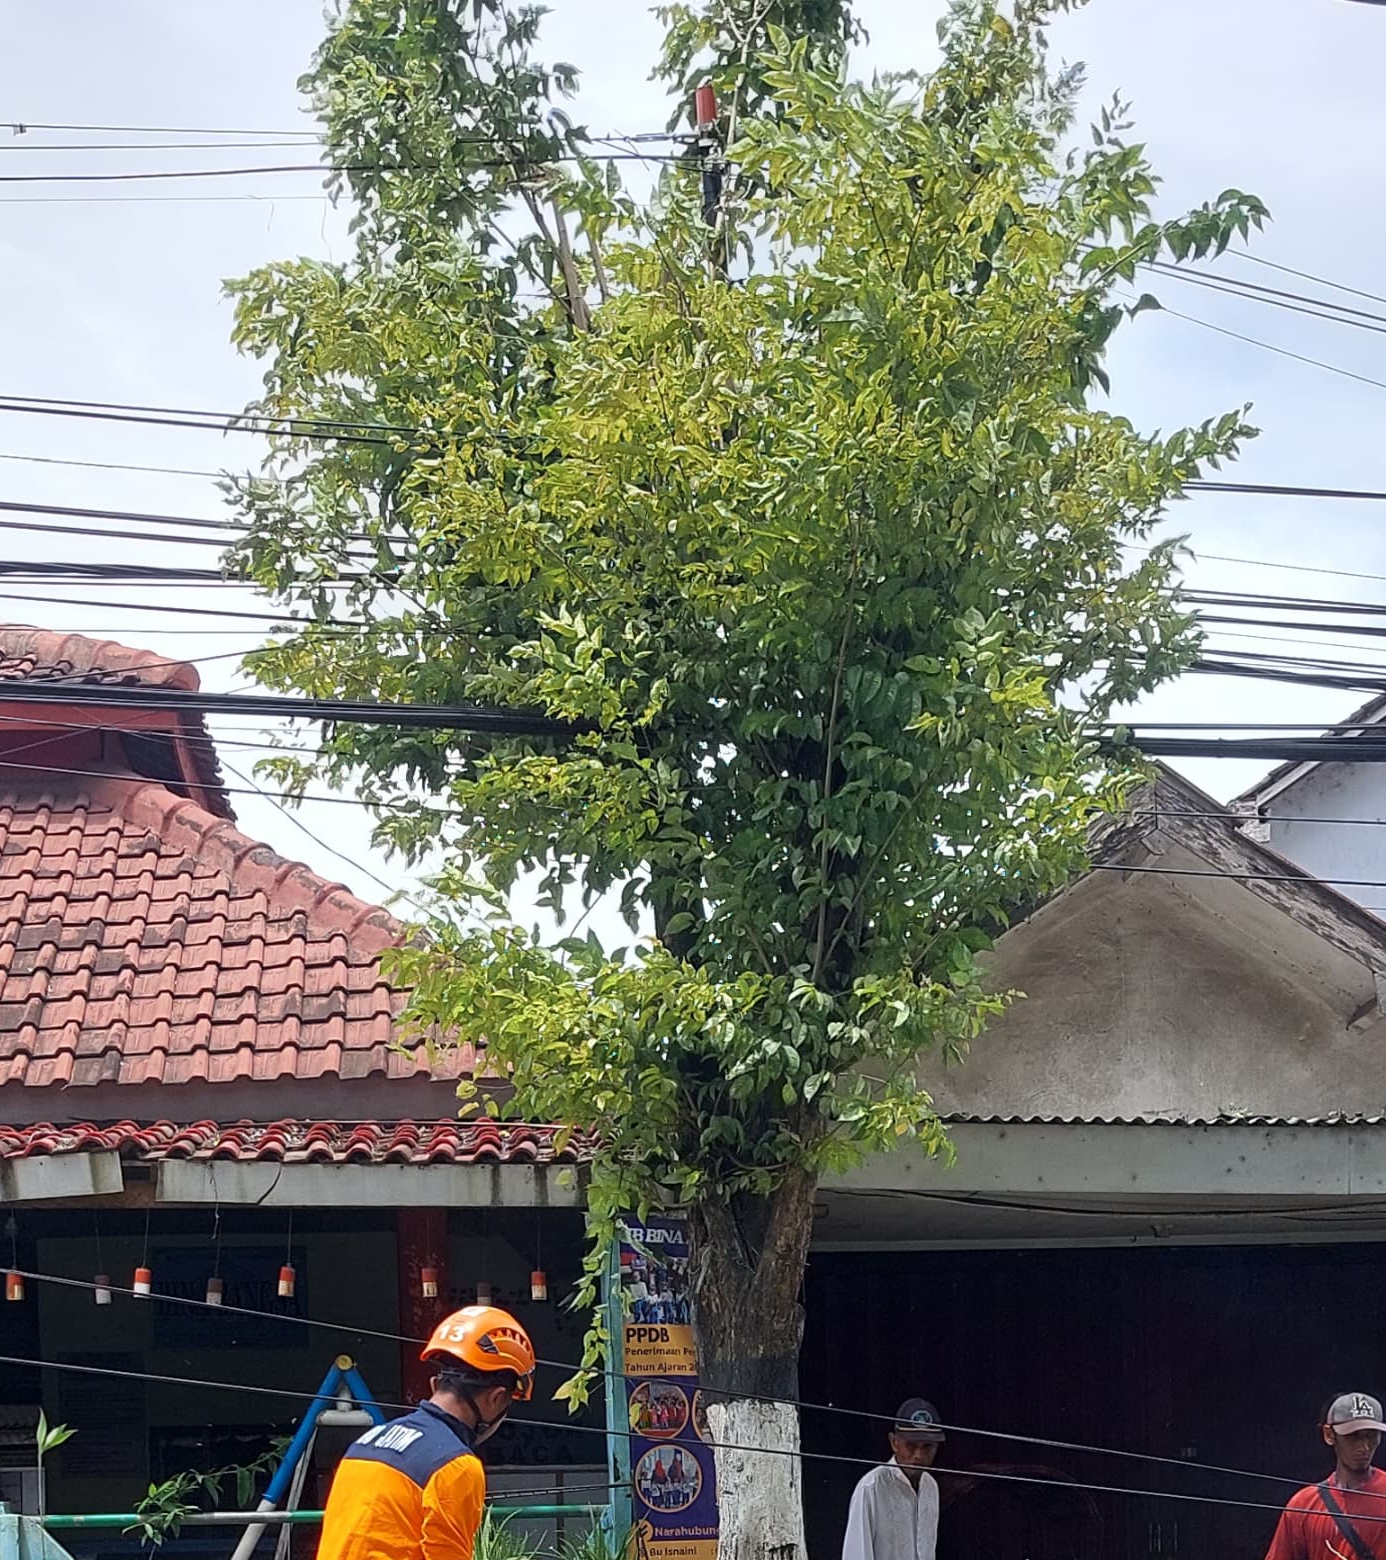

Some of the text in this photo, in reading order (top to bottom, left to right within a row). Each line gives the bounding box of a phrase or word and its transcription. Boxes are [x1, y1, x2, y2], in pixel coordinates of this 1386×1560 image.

[645, 1228, 685, 1245] BINA
[439, 1323, 466, 1342] 13
[626, 1327, 670, 1343] PPDB
[625, 1347, 681, 1356] Penerimaan
[625, 1363, 655, 1372] Tahun
[658, 1362, 687, 1373] Ajaran
[650, 1547, 697, 1556] Bu Isnaini
